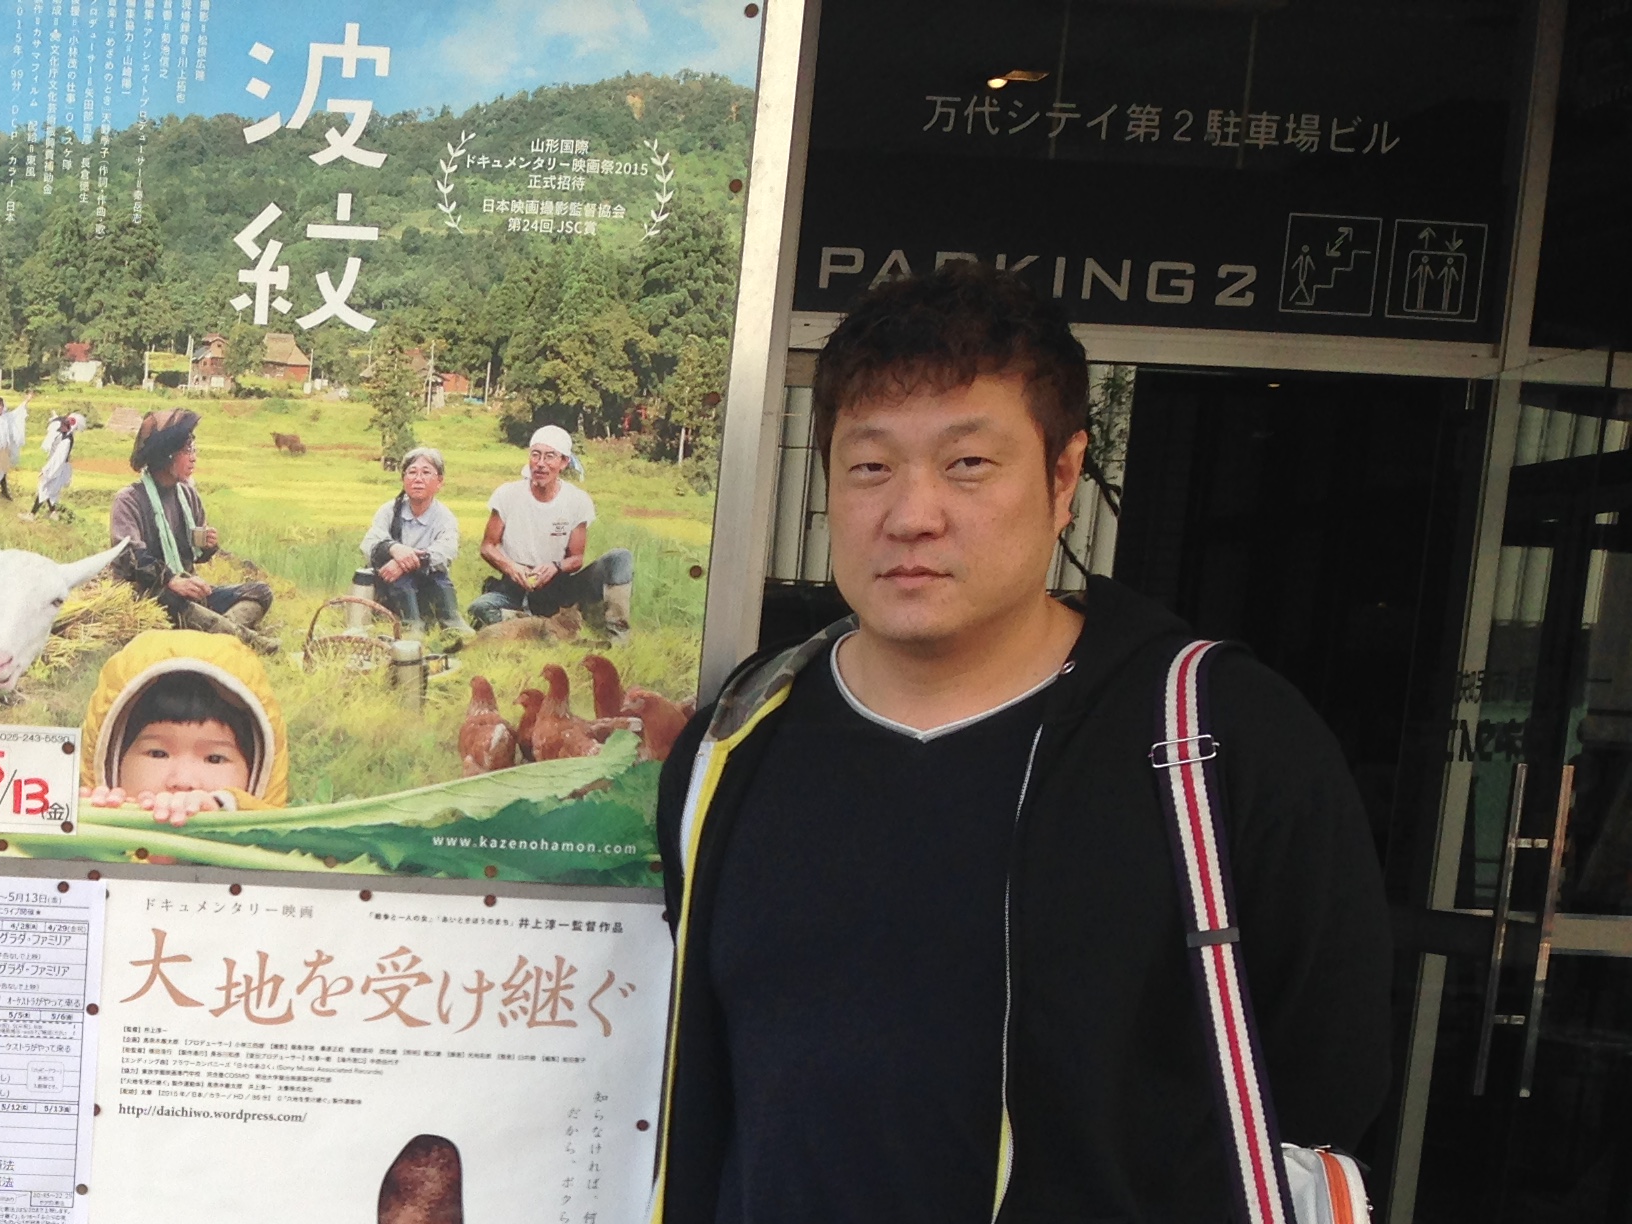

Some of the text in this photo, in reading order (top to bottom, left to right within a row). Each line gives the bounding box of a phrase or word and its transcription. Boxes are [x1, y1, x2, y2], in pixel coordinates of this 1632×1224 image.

[530, 138, 589, 155] 山形国際
[466, 154, 649, 176] ドキュメンタリー映画祭2015
[231, 22, 391, 333] 波紋
[527, 174, 585, 191] 正式招待
[482, 199, 626, 219] 日本映画撮影監督協会
[508, 217, 597, 236] 第24回 JSC賞
[817, 246, 1196, 304] PAING
[432, 835, 637, 855] www.kazenohamon.com
[144, 897, 315, 920] ドキュメンタリー映画
[120, 927, 637, 1037] 大地を受け継ぐ
[118, 1103, 307, 1123] http://daichiwo.wordpress.com/
